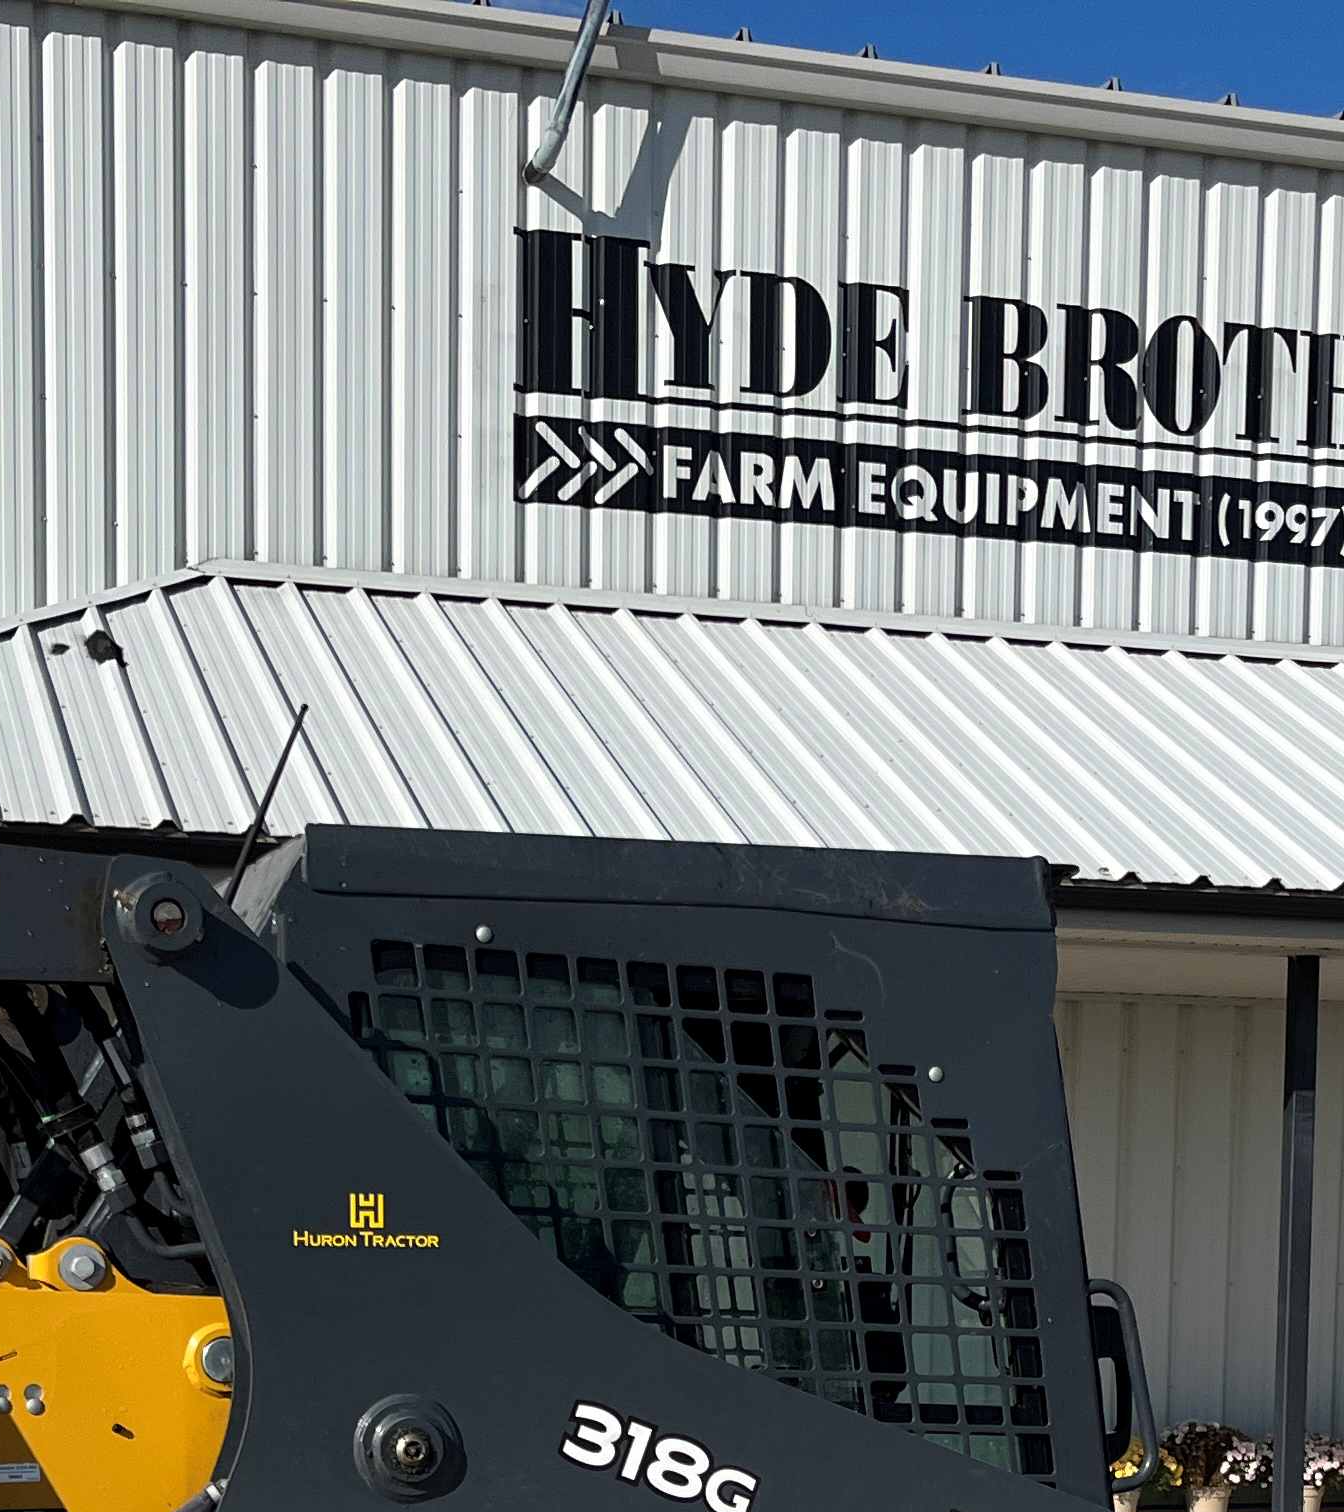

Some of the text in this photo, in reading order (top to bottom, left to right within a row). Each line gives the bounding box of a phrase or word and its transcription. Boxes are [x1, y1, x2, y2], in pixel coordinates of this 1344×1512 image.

[514, 227, 910, 408] HYDE
[661, 445, 837, 514] FARM
[857, 463, 1200, 545] EQUIPMENT
[293, 1230, 439, 1248] HURON TRACTOR
